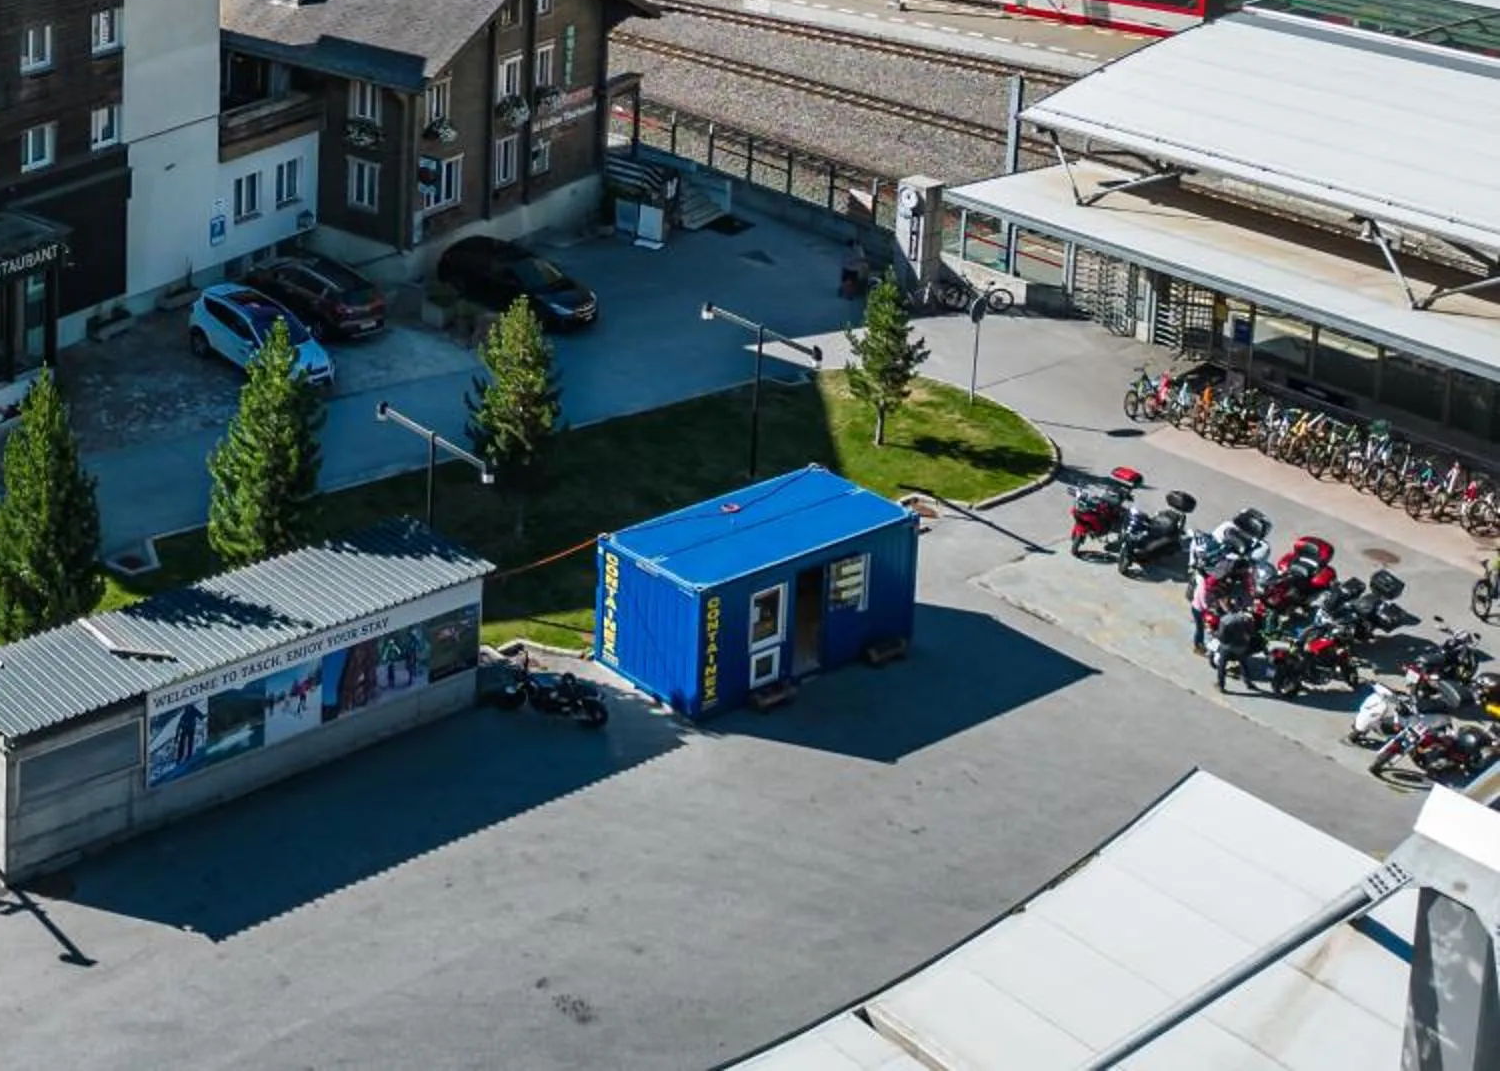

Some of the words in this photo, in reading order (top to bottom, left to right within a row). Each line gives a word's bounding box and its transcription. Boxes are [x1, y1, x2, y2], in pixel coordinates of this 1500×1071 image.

[152, 677, 217, 709] WELCOME
[222, 670, 237, 685] TO
[286, 638, 324, 662] ENJOY
[327, 629, 358, 647] YOUR
[360, 616, 390, 636] STAY
